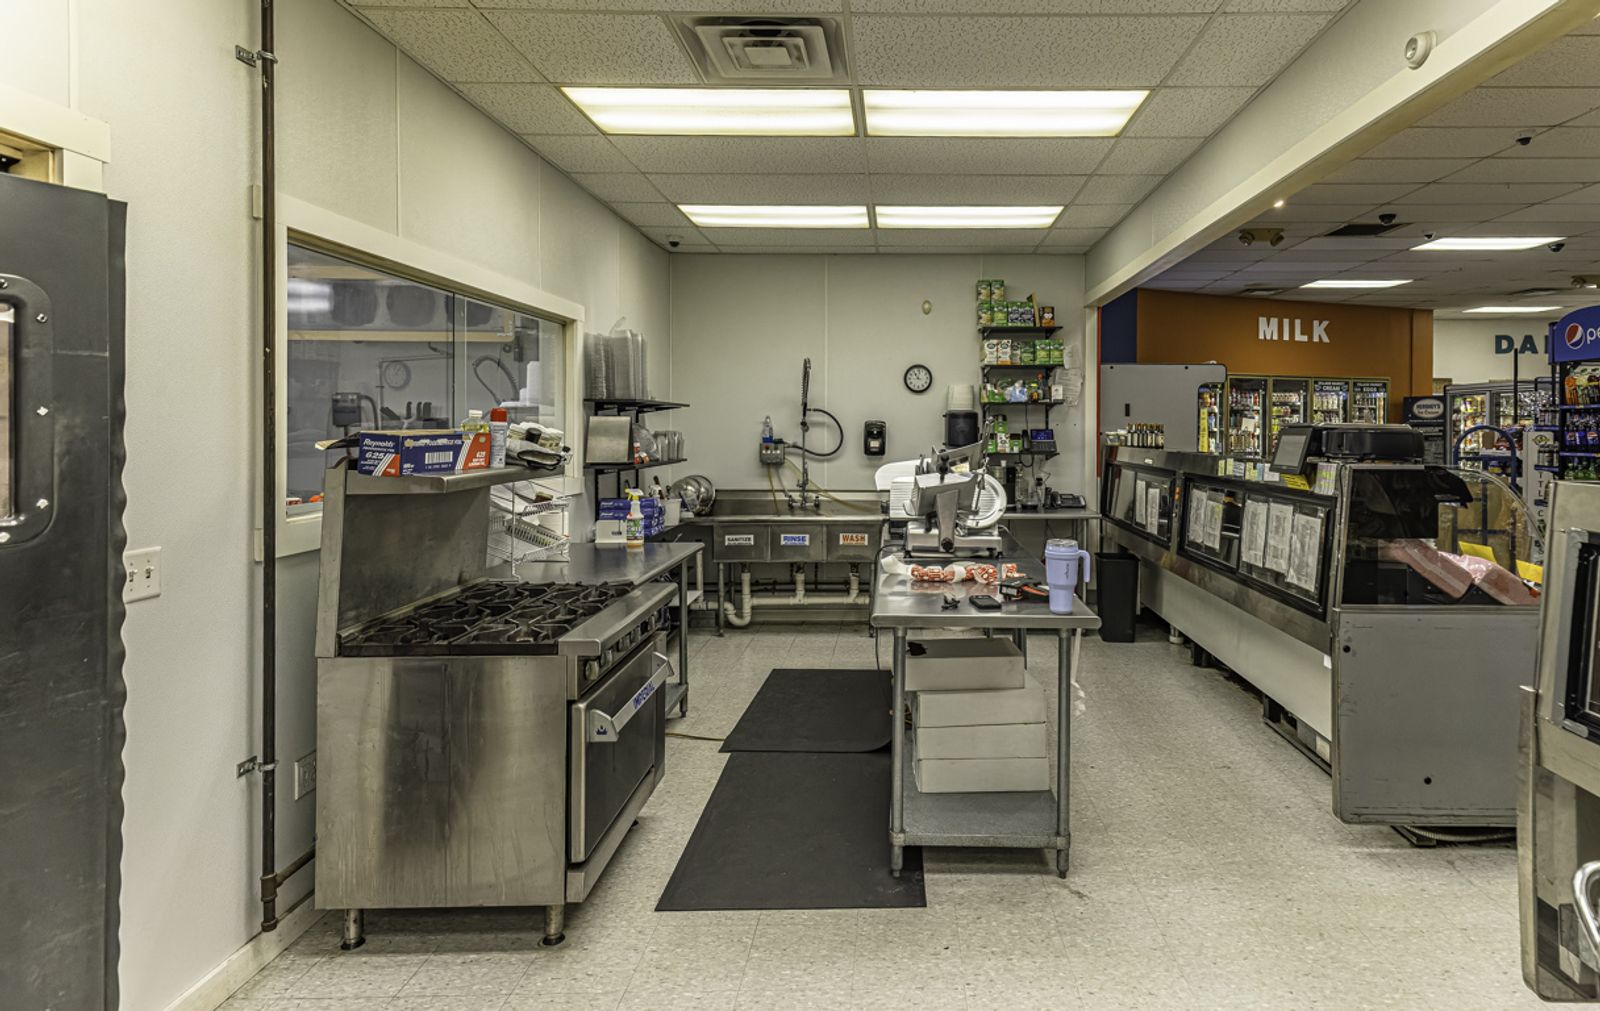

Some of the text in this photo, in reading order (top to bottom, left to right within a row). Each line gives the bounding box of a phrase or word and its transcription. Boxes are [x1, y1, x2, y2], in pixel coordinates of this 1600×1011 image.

[1258, 316, 1330, 343] MILK
[363, 438, 396, 448] Reynolds
[365, 452, 386, 460] 625
[783, 535, 807, 543] RINSE
[842, 534, 865, 542] WASH
